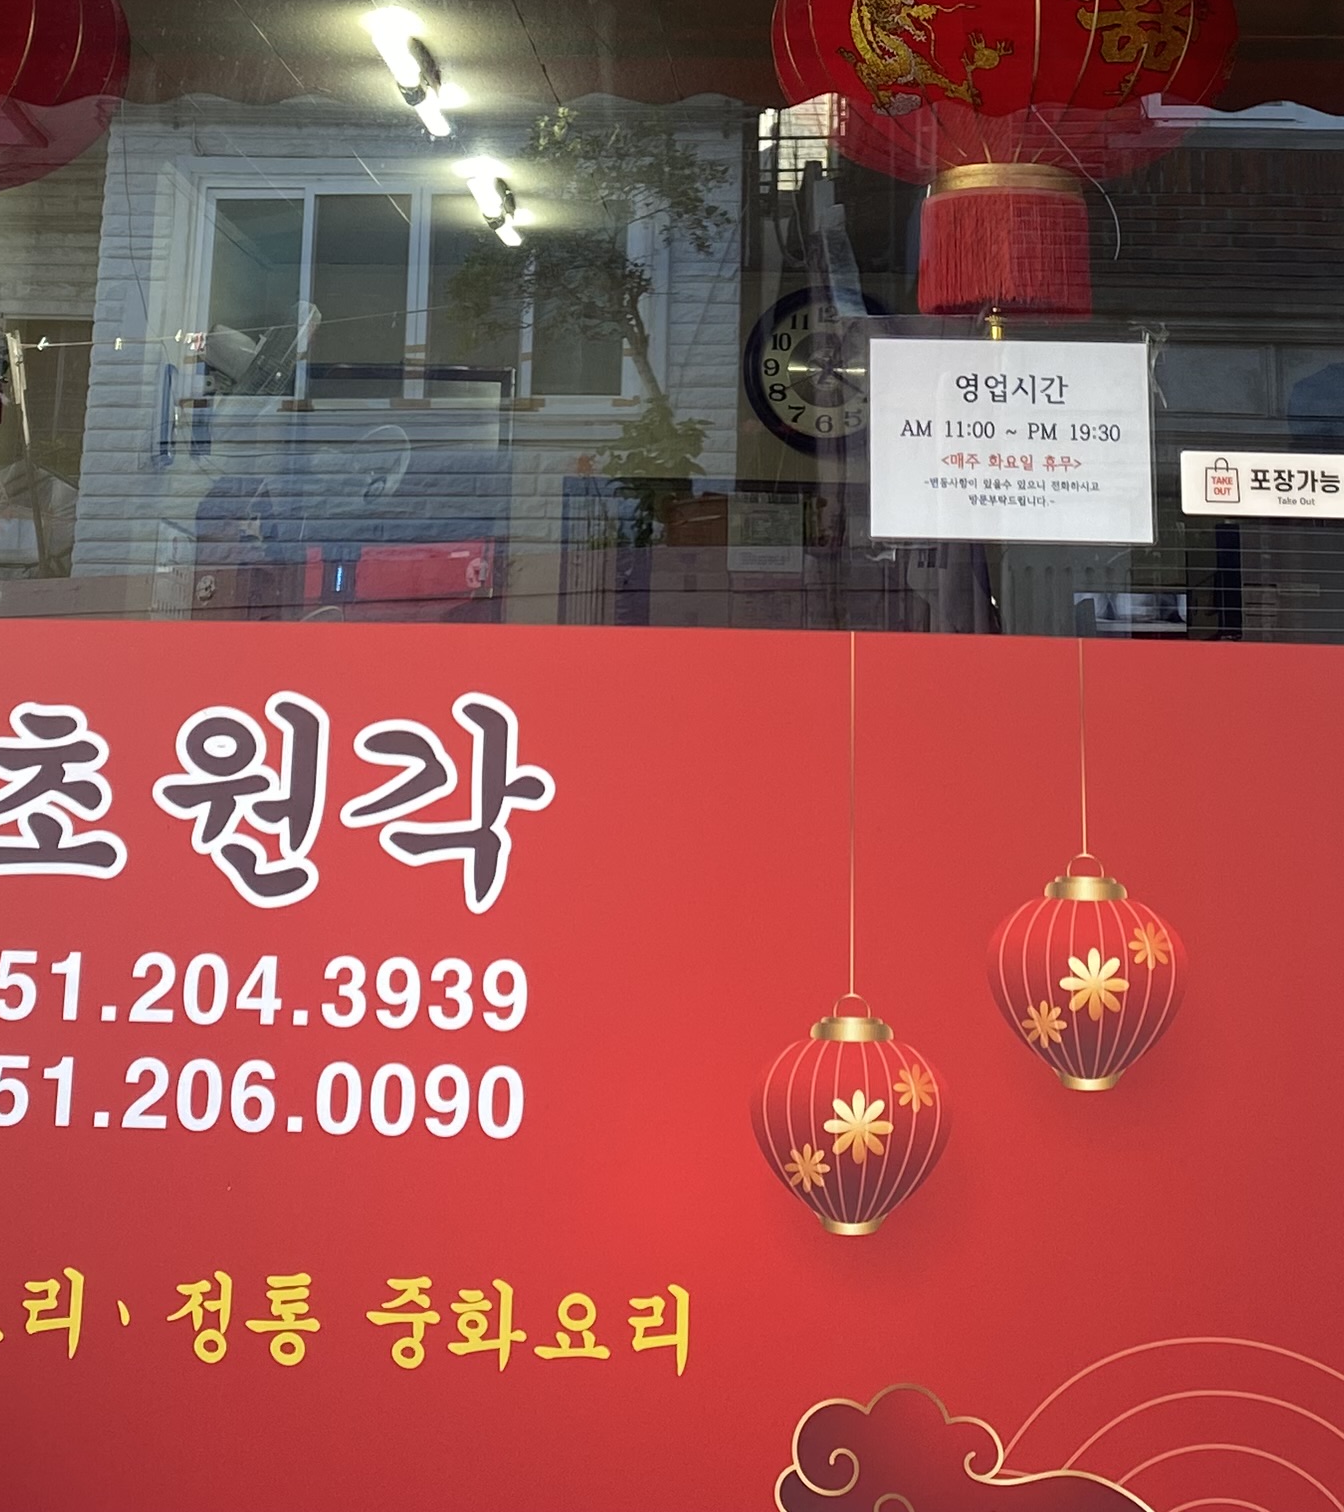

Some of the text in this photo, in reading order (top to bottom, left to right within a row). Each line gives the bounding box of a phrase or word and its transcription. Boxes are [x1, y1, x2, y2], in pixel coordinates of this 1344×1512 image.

[790, 314, 810, 331] 11
[771, 332, 793, 352] 10
[763, 358, 780, 377] 9
[768, 383, 788, 402] 8
[954, 373, 1070, 407] 영업시간
[787, 404, 807, 424] 7
[815, 414, 834, 434] 6
[900, 419, 933, 440] AM
[944, 419, 996, 441] 11:00
[1027, 421, 1058, 442] PM
[1069, 422, 1121, 443] 19:30
[941, 453, 1083, 473] <매주 화요일 휴무>
[1017, 479, 1047, 492] 있으니
[1210, 475, 1234, 486] TAKE
[1250, 468, 1341, 494] 포장가능
[1213, 487, 1233, 497] OUT
[1277, 496, 1316, 506] Take Out
[365, 1275, 694, 1377] 중화요리
